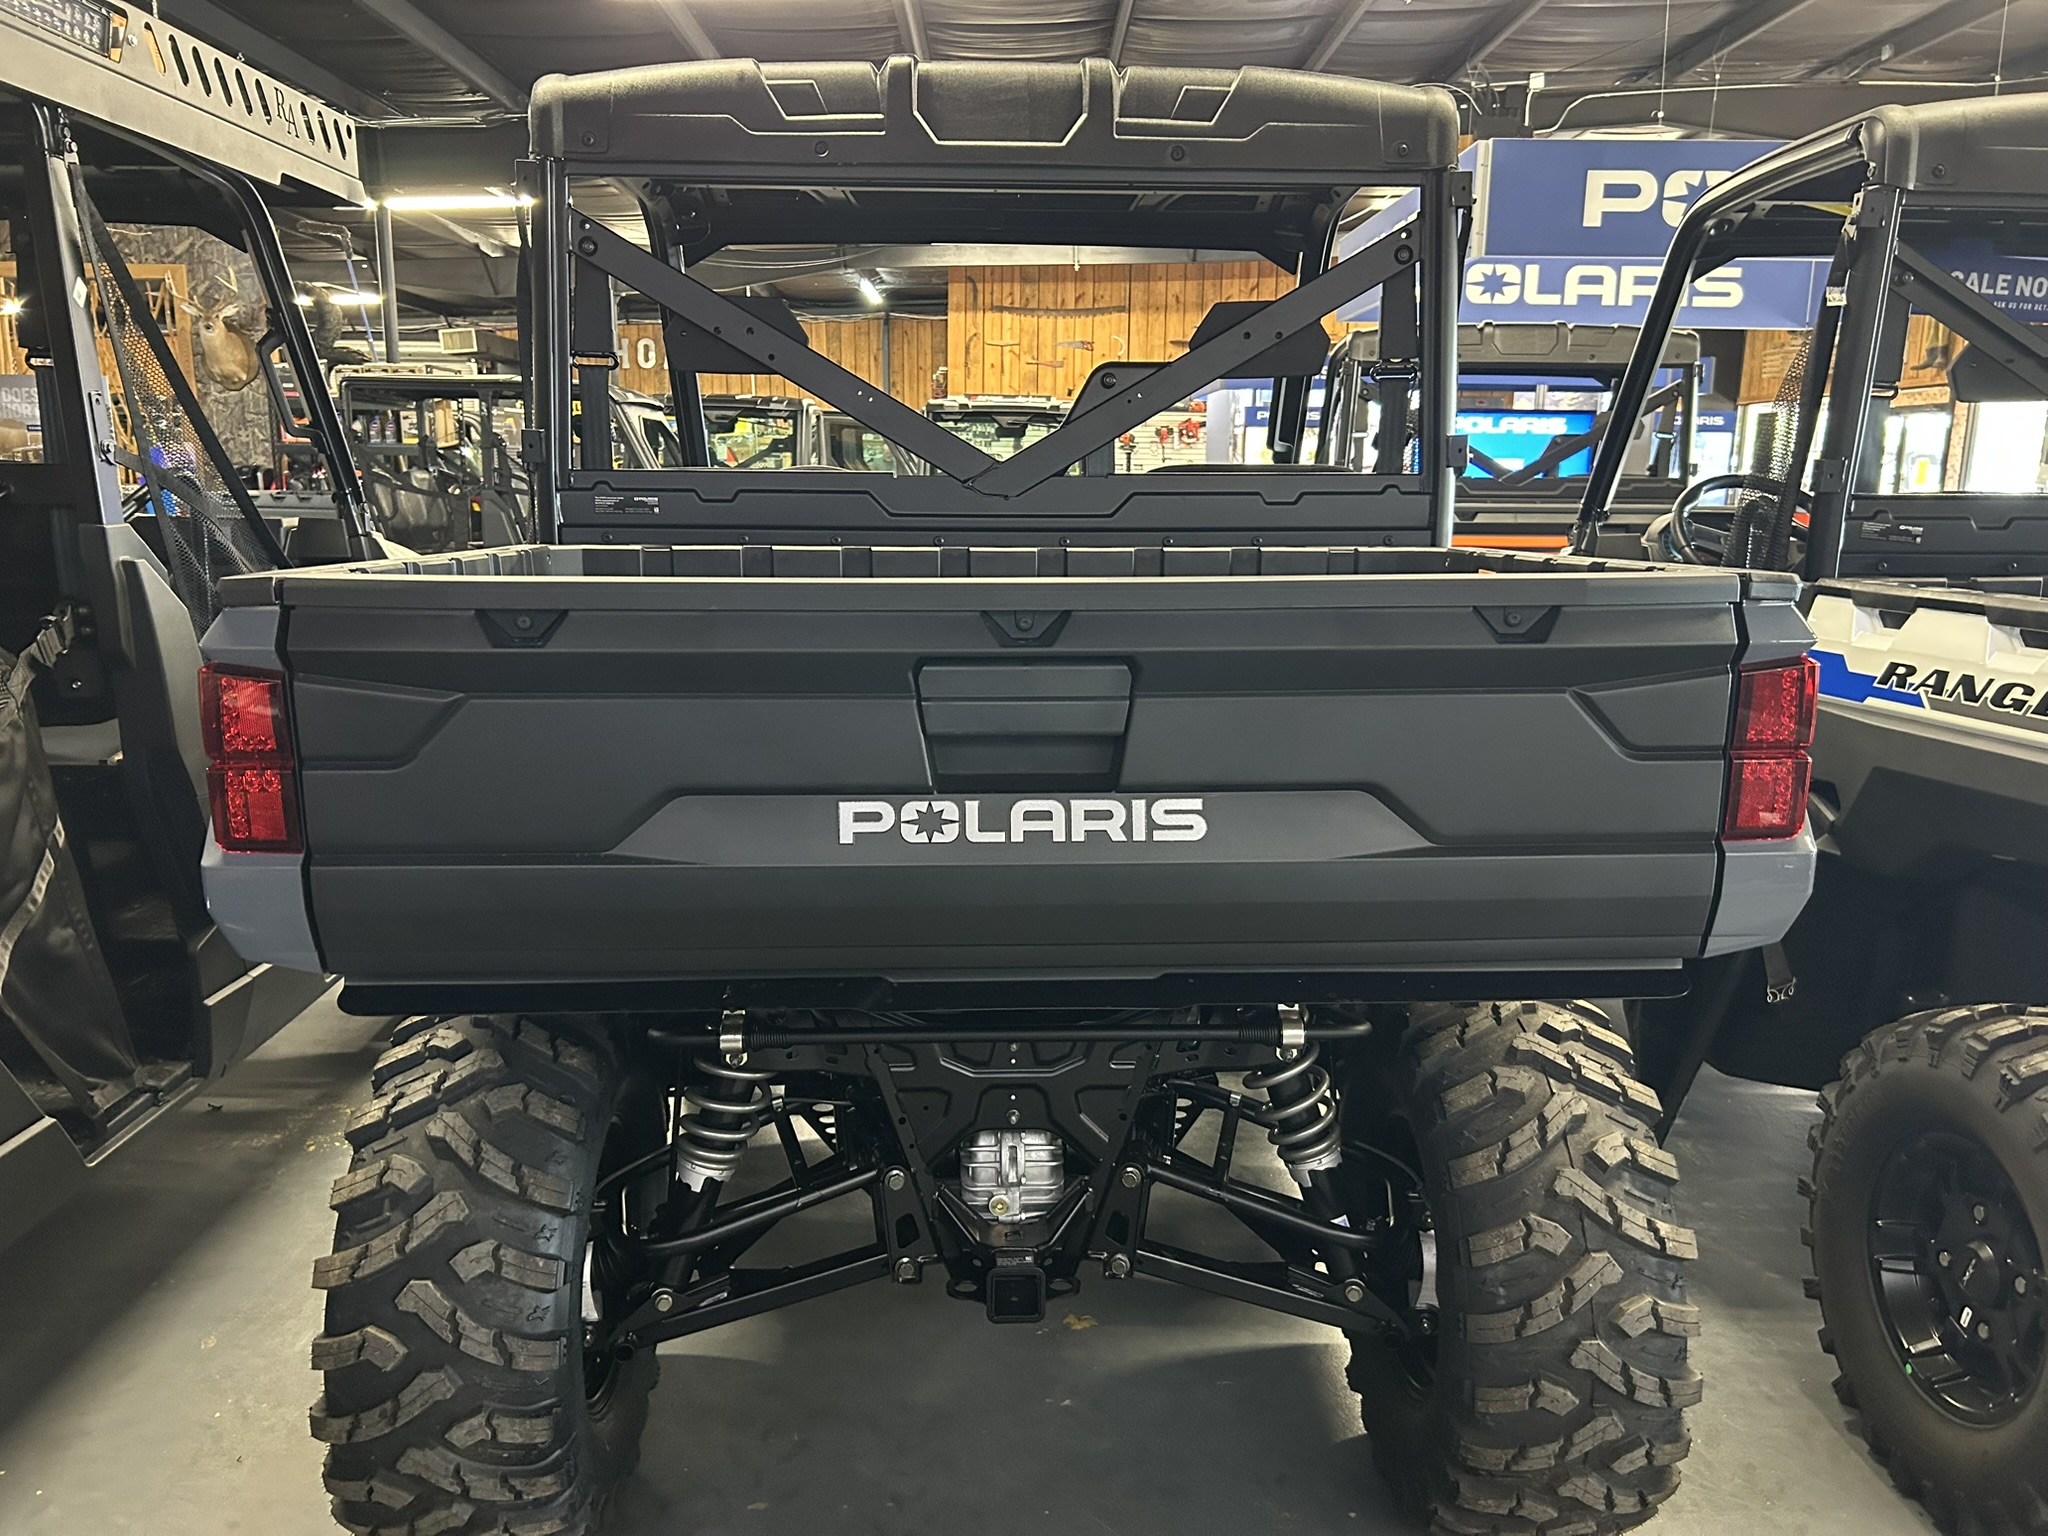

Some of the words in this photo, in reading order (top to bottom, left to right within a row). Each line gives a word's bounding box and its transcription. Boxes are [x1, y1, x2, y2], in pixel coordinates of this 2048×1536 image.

[1465, 264, 1744, 308] OLARS
[2015, 275, 2048, 298] NO
[838, 799, 1208, 844] POLARIS
